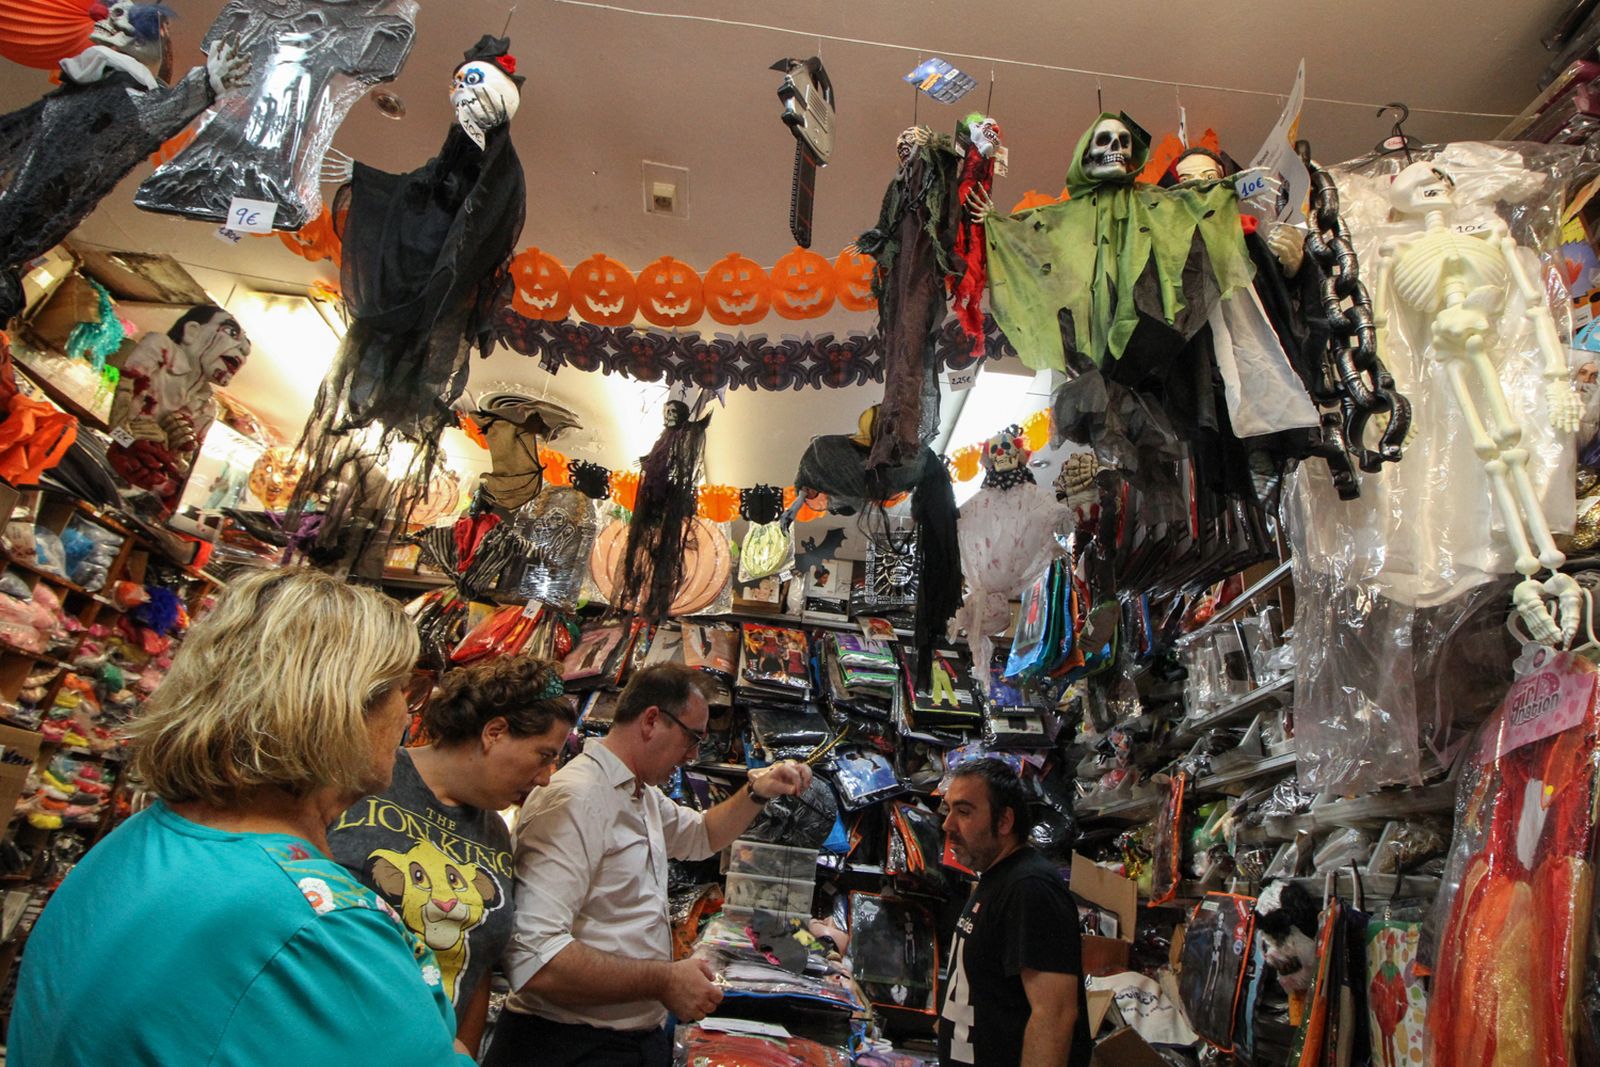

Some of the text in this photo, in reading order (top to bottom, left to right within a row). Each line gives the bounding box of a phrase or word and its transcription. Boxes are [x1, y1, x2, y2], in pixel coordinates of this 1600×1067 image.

[1241, 177, 1264, 197] 10€
[236, 208, 260, 225] 9€
[1456, 222, 1487, 234] 10€
[1517, 692, 1560, 721] nation
[426, 807, 456, 830] THE
[334, 799, 513, 879] LION KING
